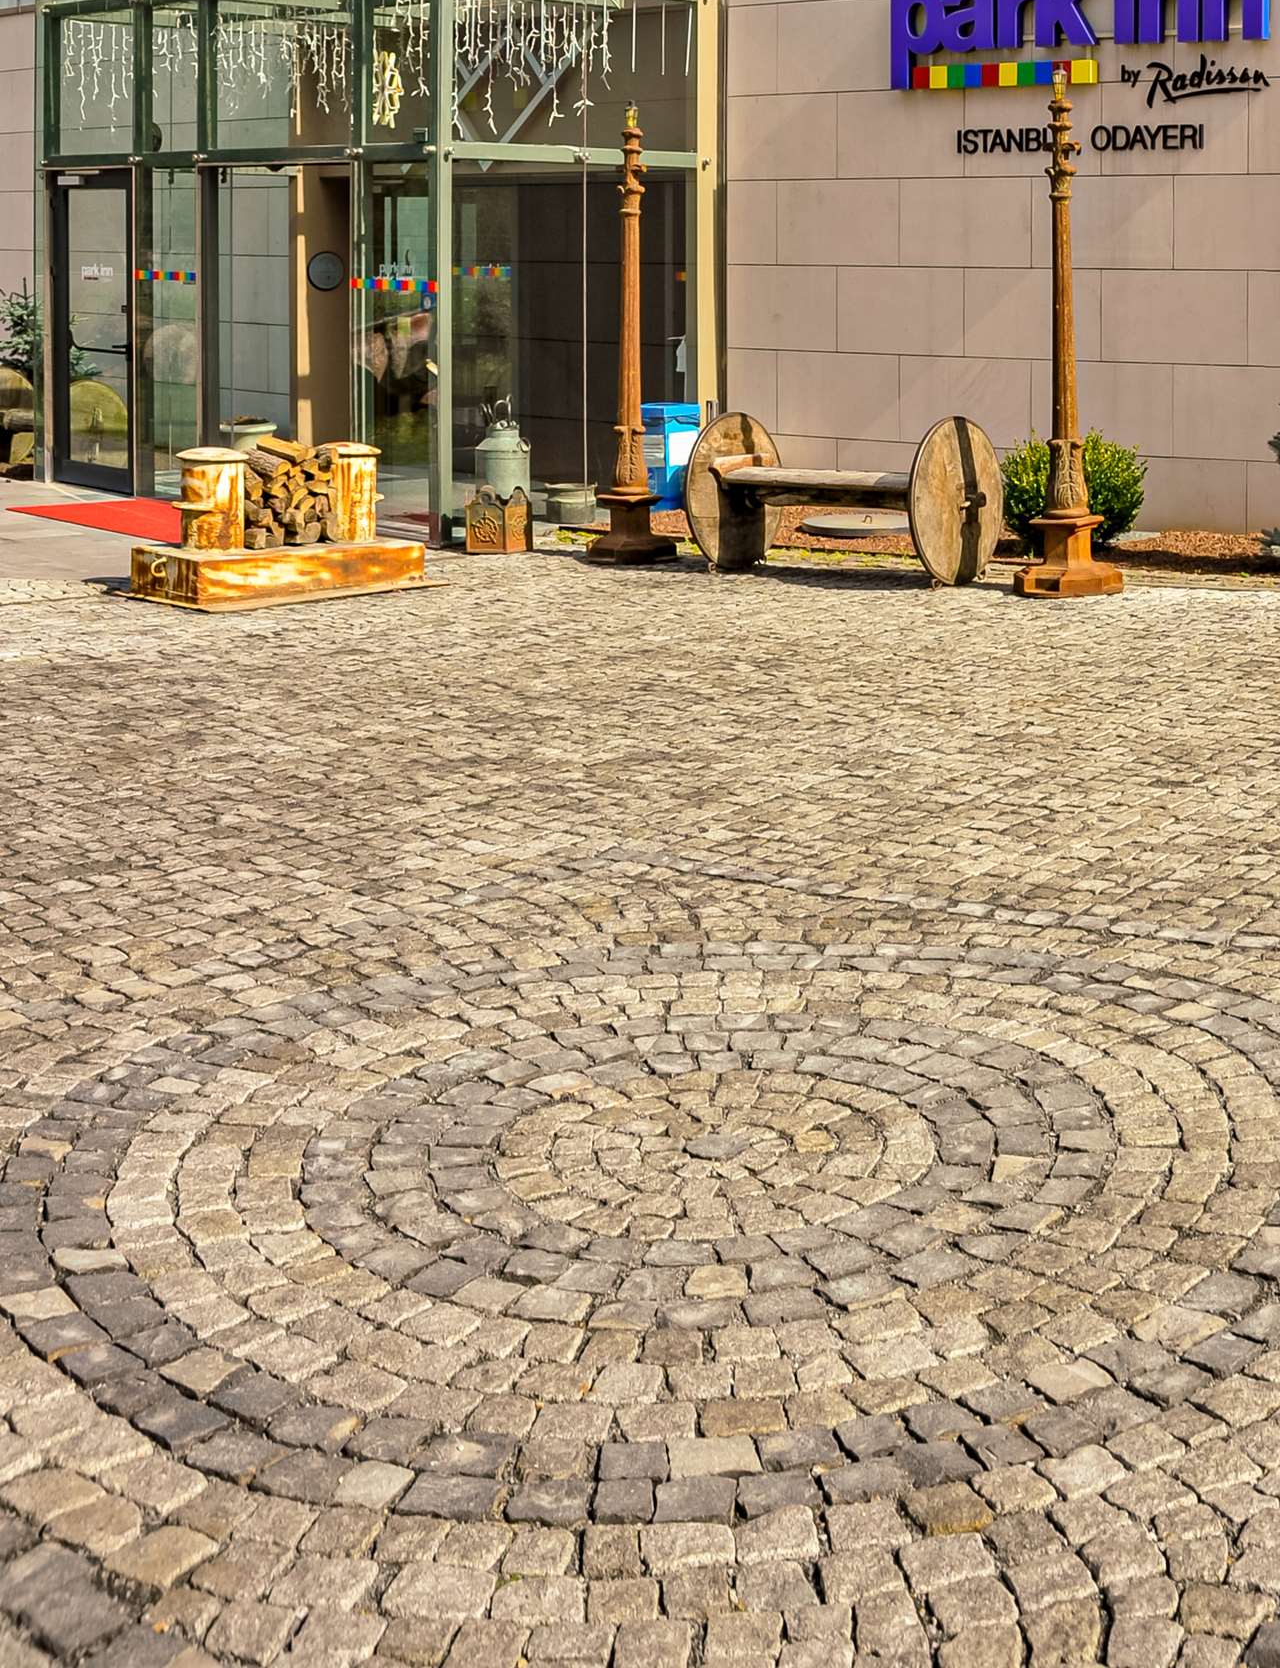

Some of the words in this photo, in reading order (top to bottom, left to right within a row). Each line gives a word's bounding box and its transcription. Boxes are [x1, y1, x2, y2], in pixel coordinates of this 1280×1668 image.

[1121, 64, 1141, 88] by
[1146, 53, 1270, 109] Radisson
[1090, 123, 1204, 152] ODAYERI
